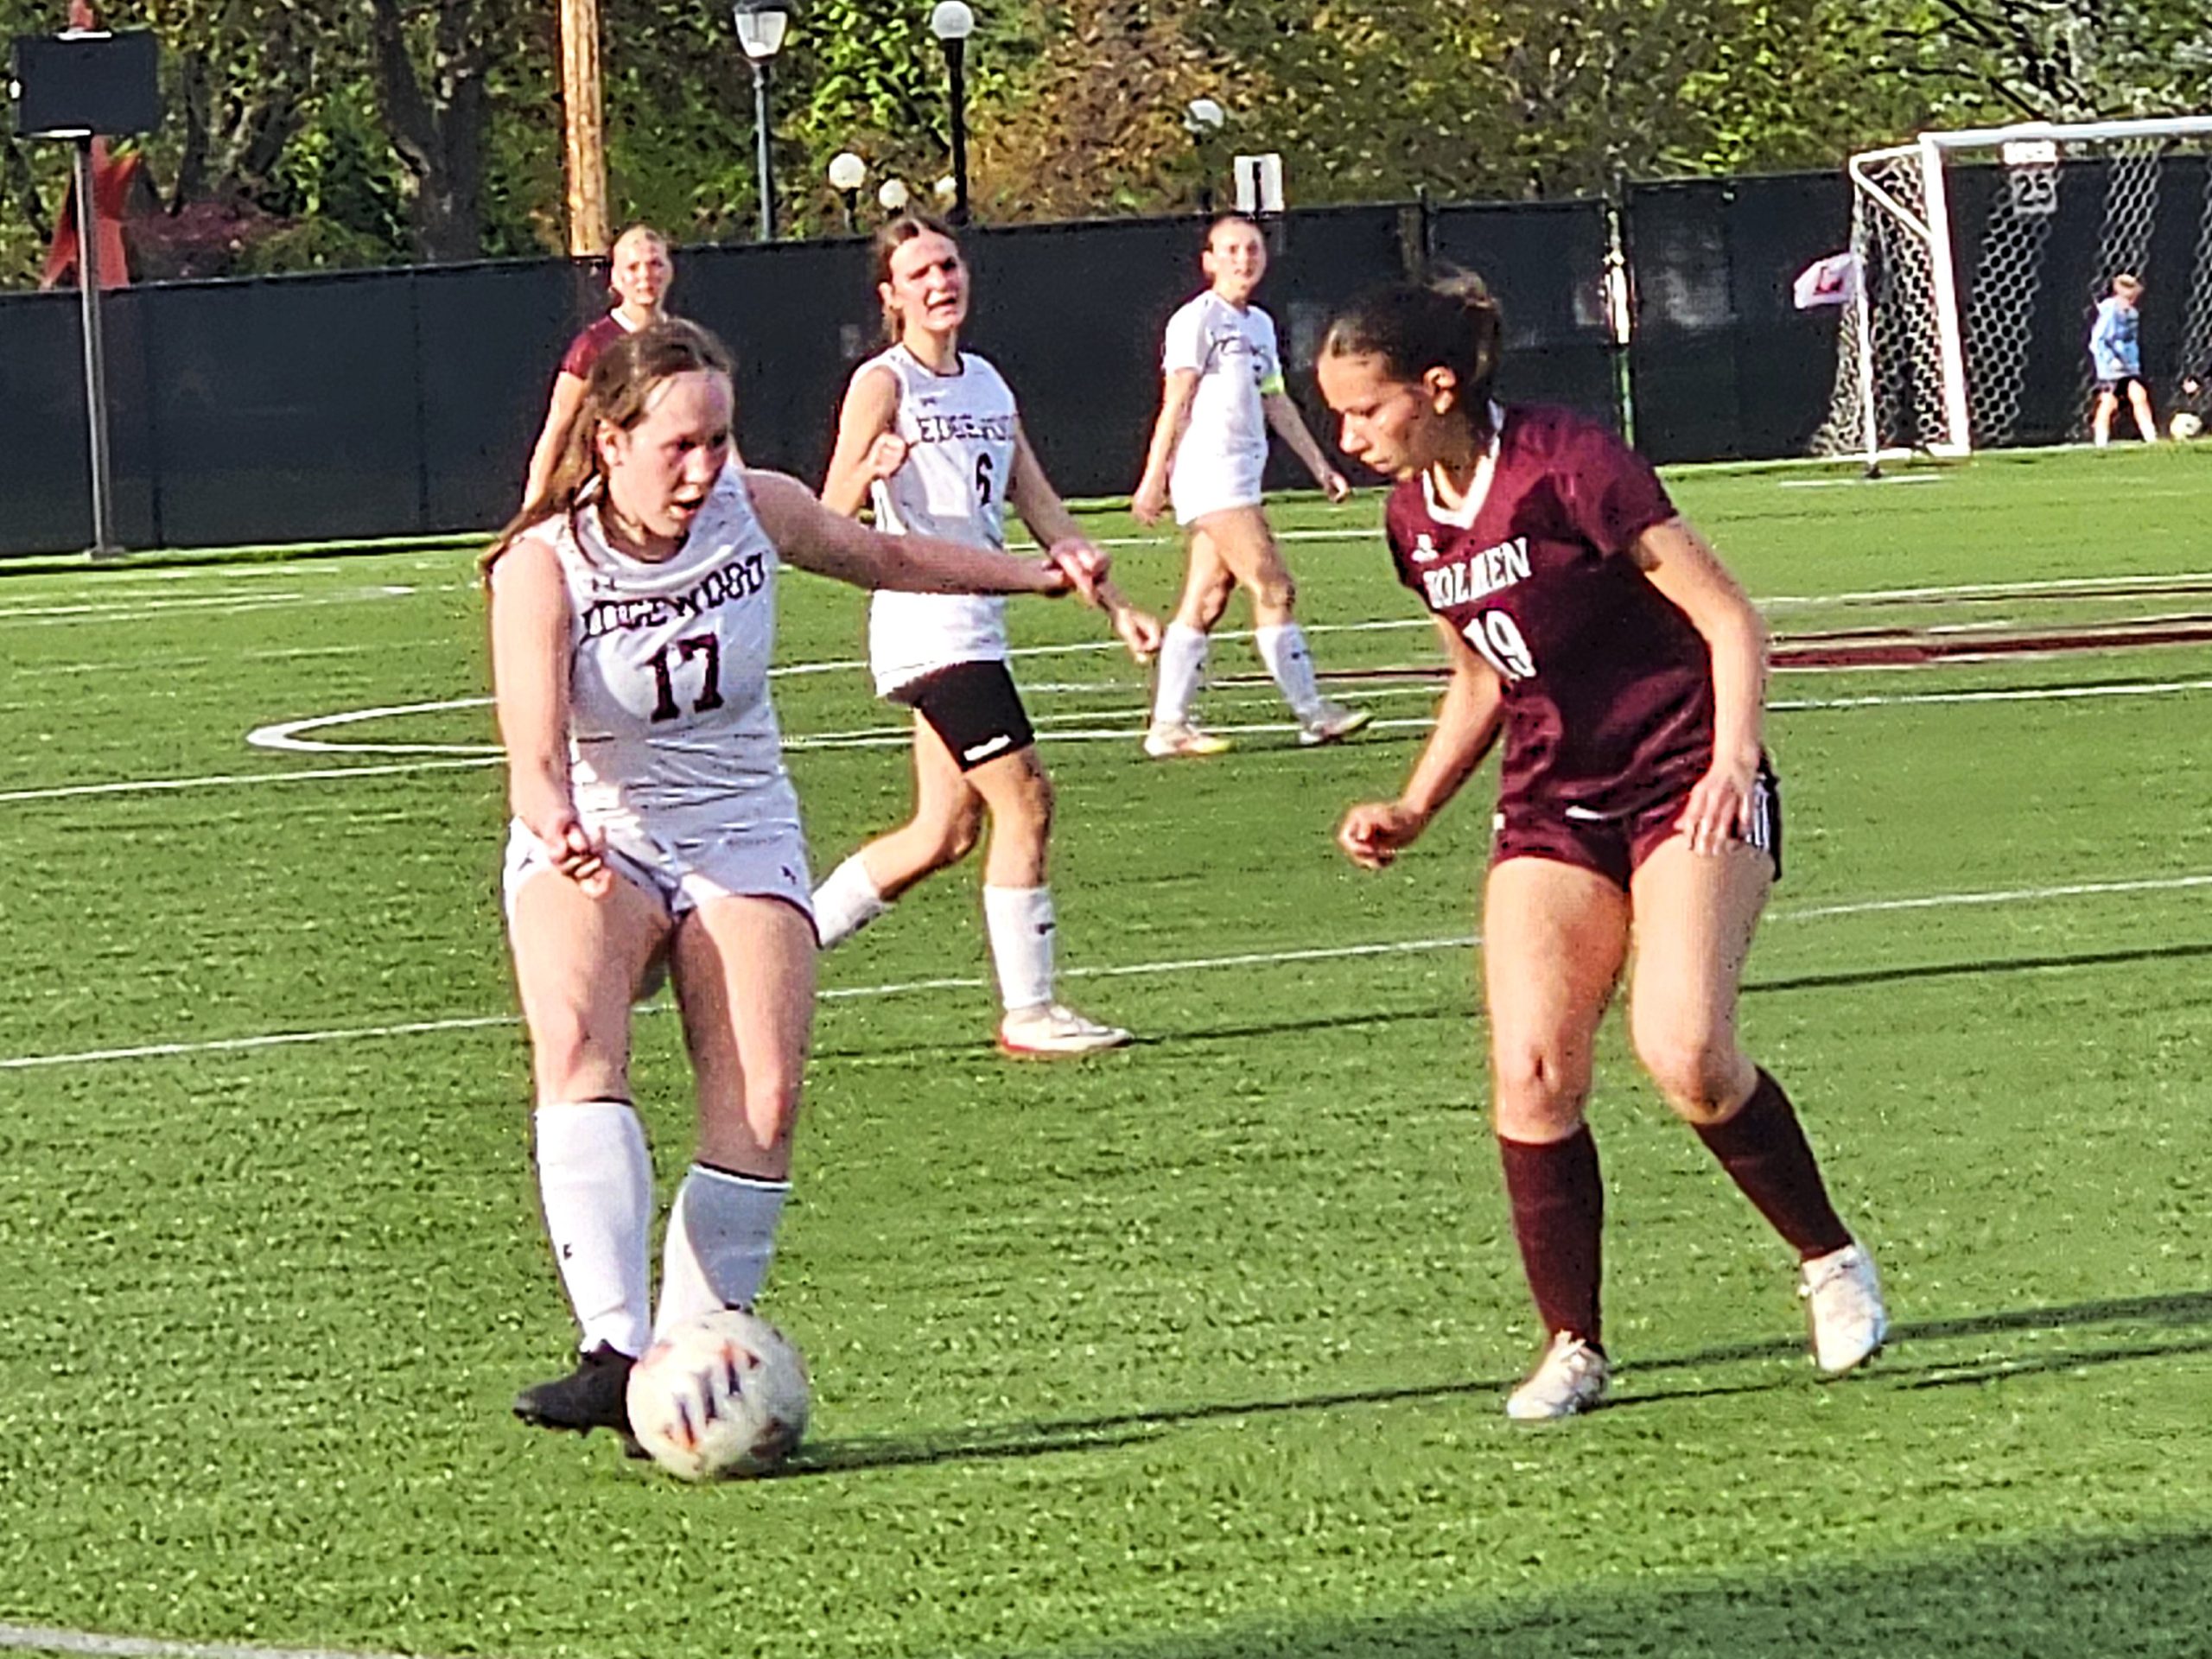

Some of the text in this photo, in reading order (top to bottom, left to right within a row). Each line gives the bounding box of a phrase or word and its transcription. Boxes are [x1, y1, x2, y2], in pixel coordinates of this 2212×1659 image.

[2014, 174, 2053, 207] 25
[976, 452, 994, 507] 6
[1462, 609, 1537, 682] 19
[645, 632, 725, 724] 17
